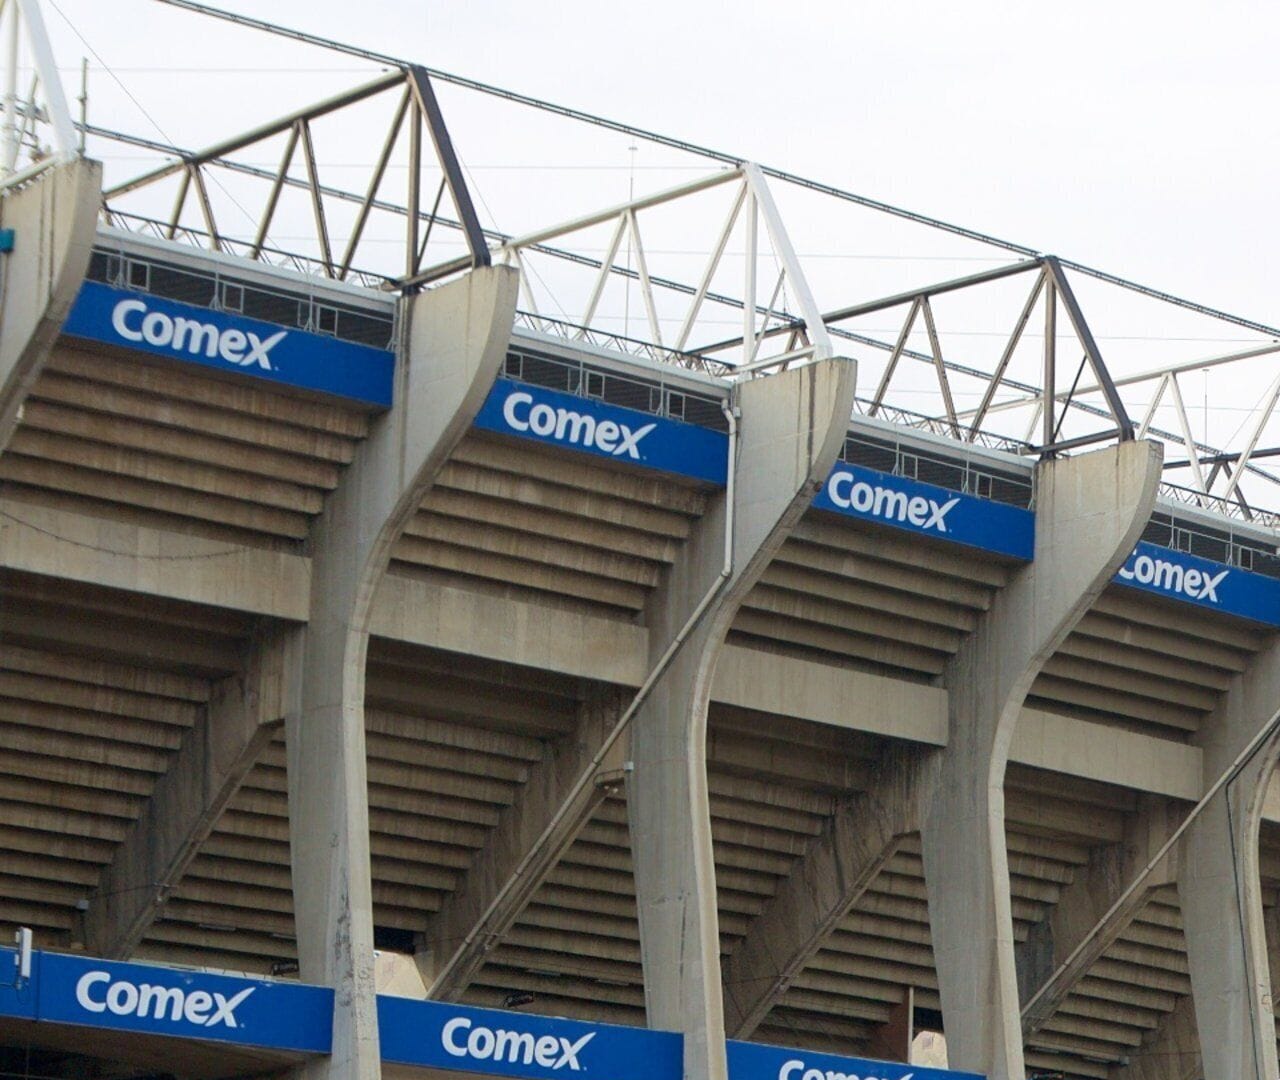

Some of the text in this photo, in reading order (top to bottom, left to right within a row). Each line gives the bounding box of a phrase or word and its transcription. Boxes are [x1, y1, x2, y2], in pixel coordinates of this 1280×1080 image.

[113, 300, 286, 370] Comex
[503, 392, 655, 459] Comex
[828, 471, 959, 532] Comex
[76, 971, 254, 1027] Comex
[442, 1017, 595, 1070] Comex
